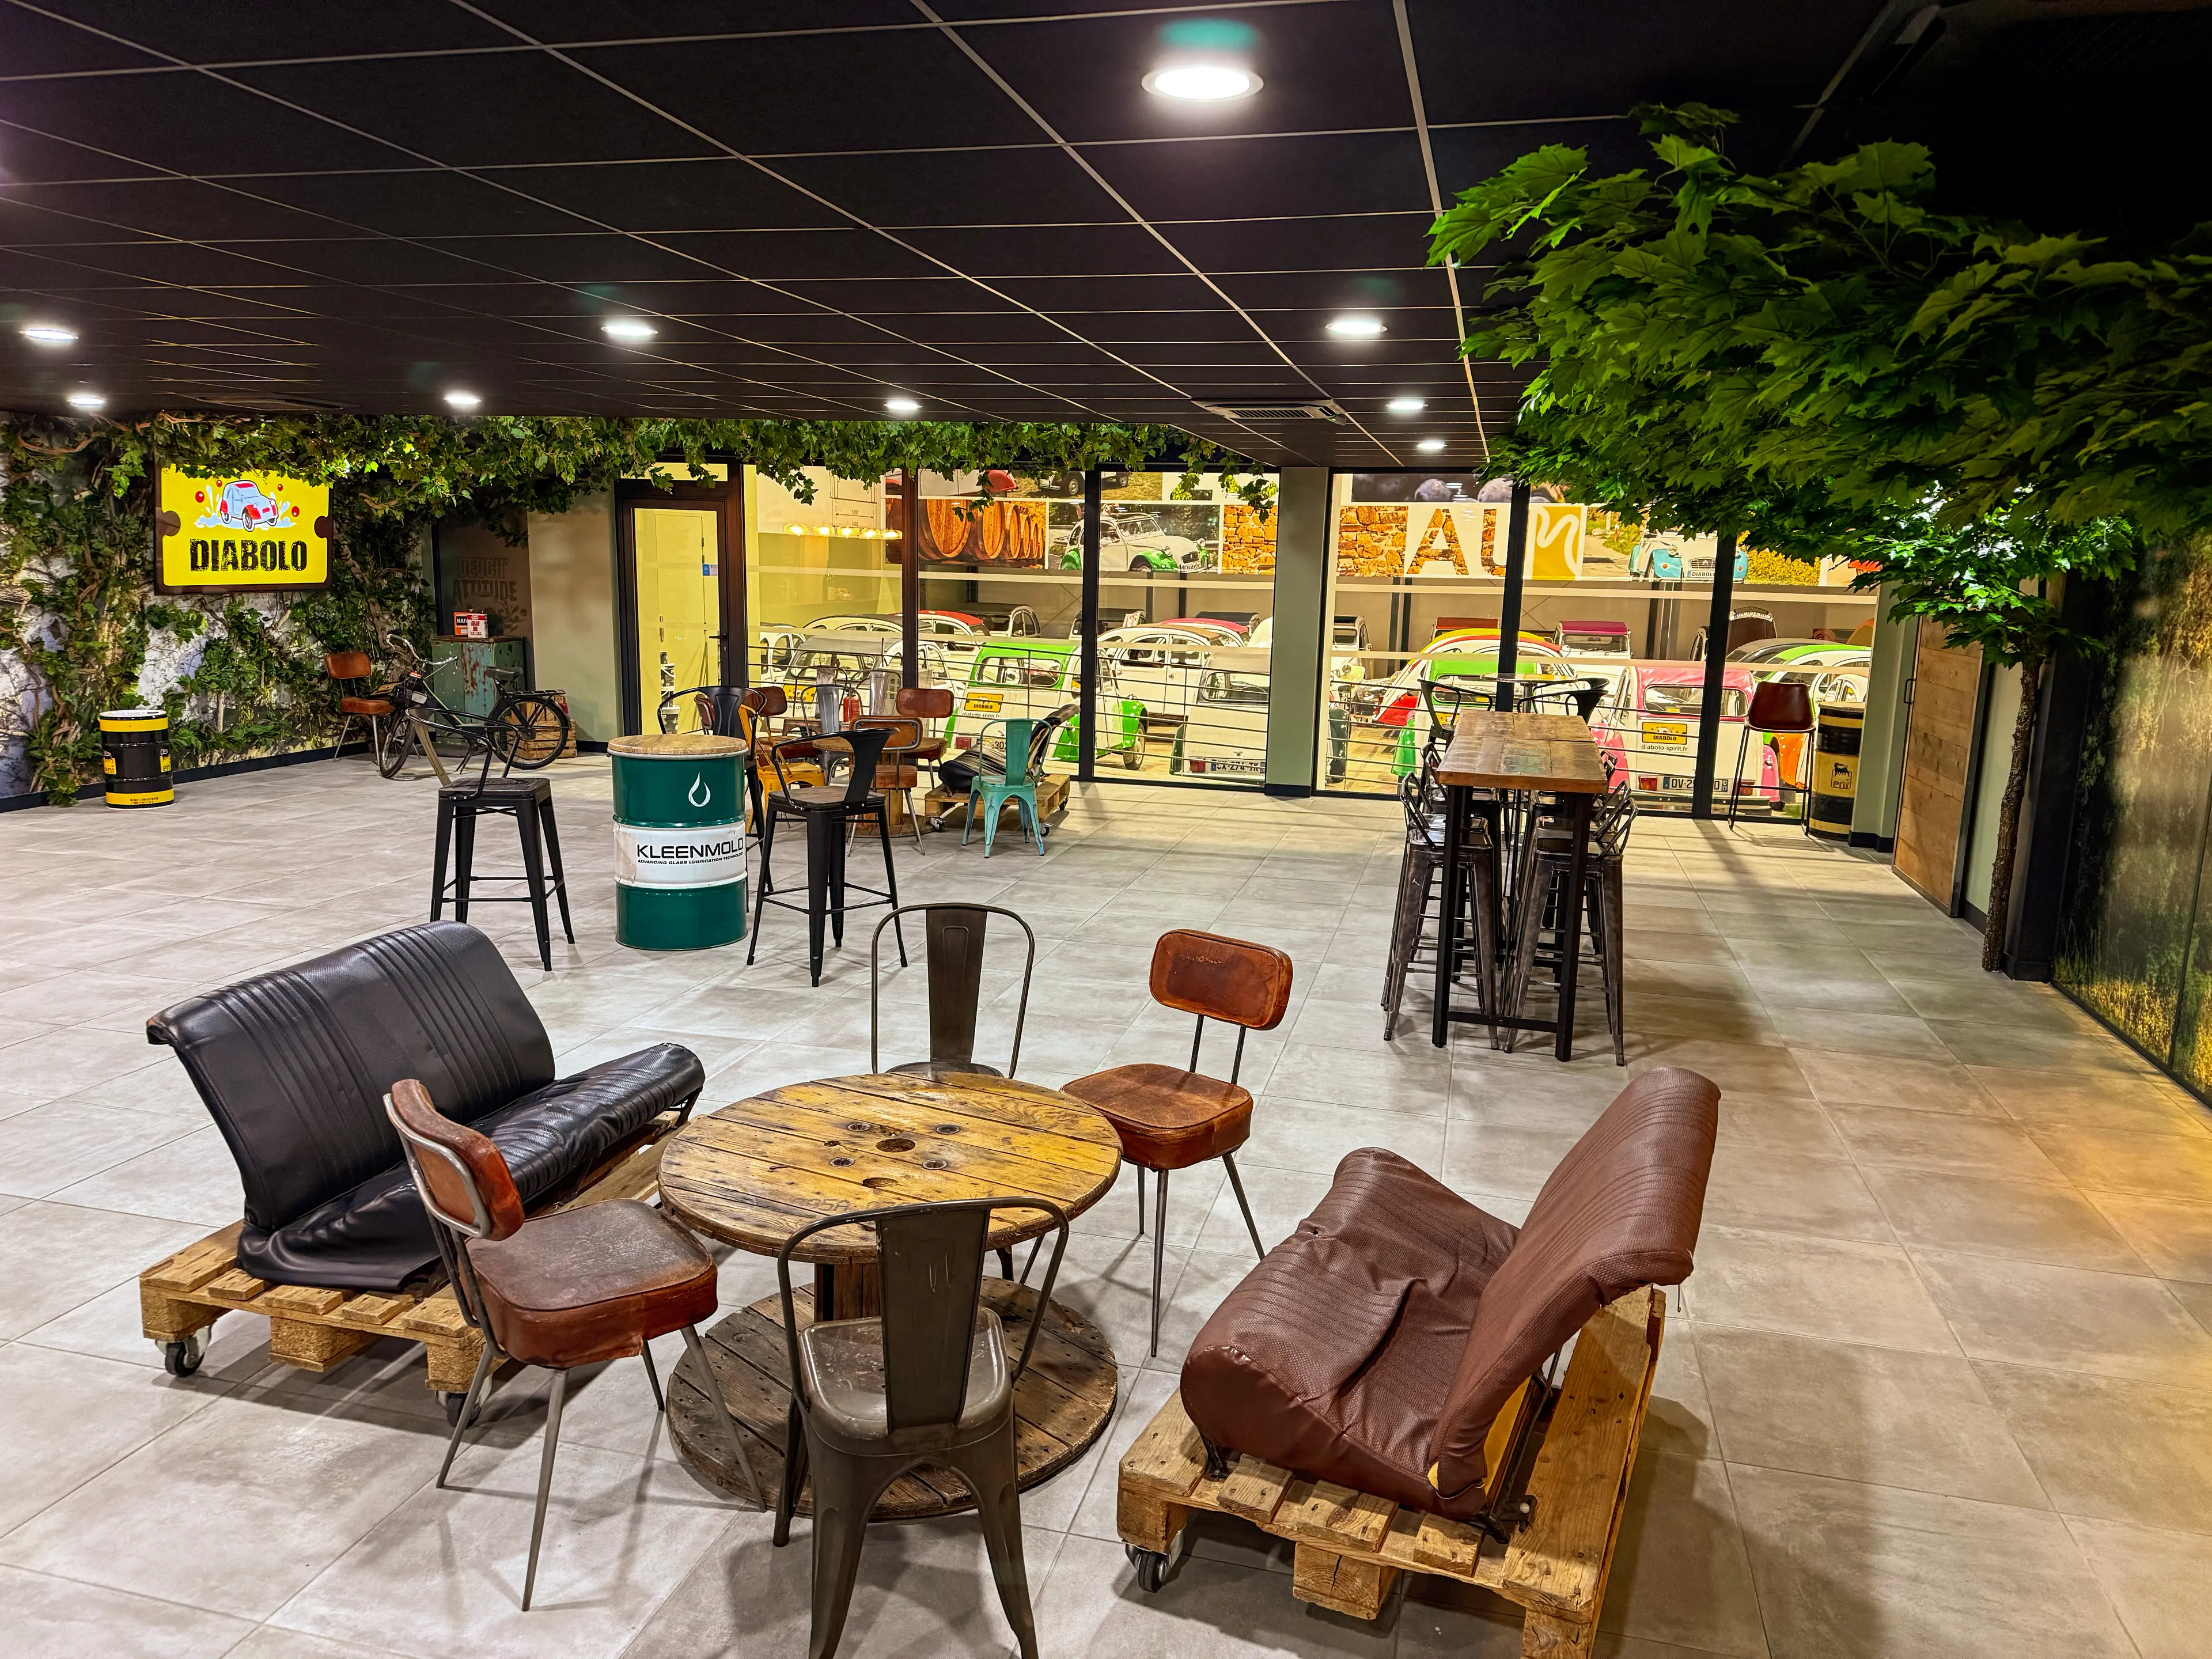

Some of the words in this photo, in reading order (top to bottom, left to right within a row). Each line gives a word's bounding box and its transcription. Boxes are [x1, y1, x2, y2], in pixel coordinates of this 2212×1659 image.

[190, 539, 308, 572] DIABOLO
[1833, 779, 1850, 789] eni
[637, 838, 743, 859] KLEENMOLD
